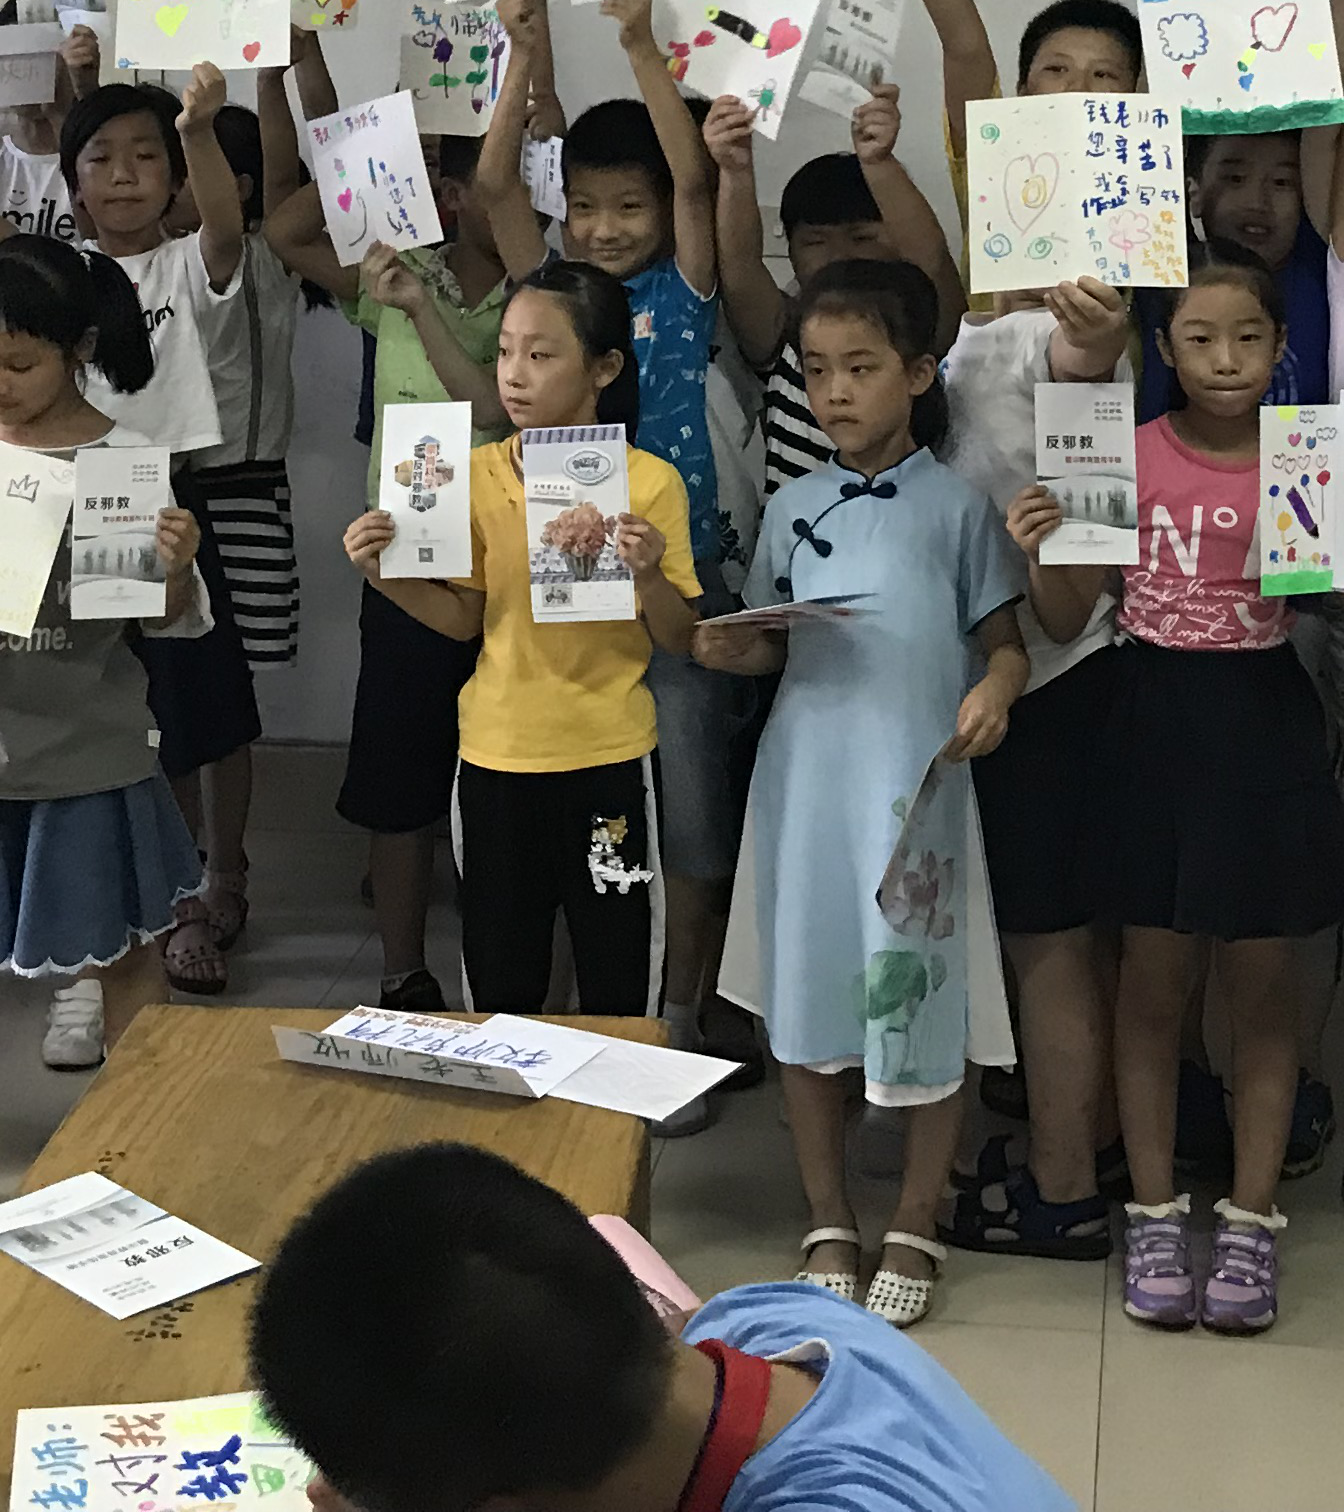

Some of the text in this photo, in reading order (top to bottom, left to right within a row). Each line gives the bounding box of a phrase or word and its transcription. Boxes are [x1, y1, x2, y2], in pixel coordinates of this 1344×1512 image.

[1083, 98, 1169, 129] 钱老师
[1046, 435, 1094, 450] 反邪教
[84, 496, 131, 511] 反邪教
[299, 1032, 498, 1086] 王老师收
[119, 1233, 196, 1269] 反邪教
[95, 1412, 167, 1497] 对我
